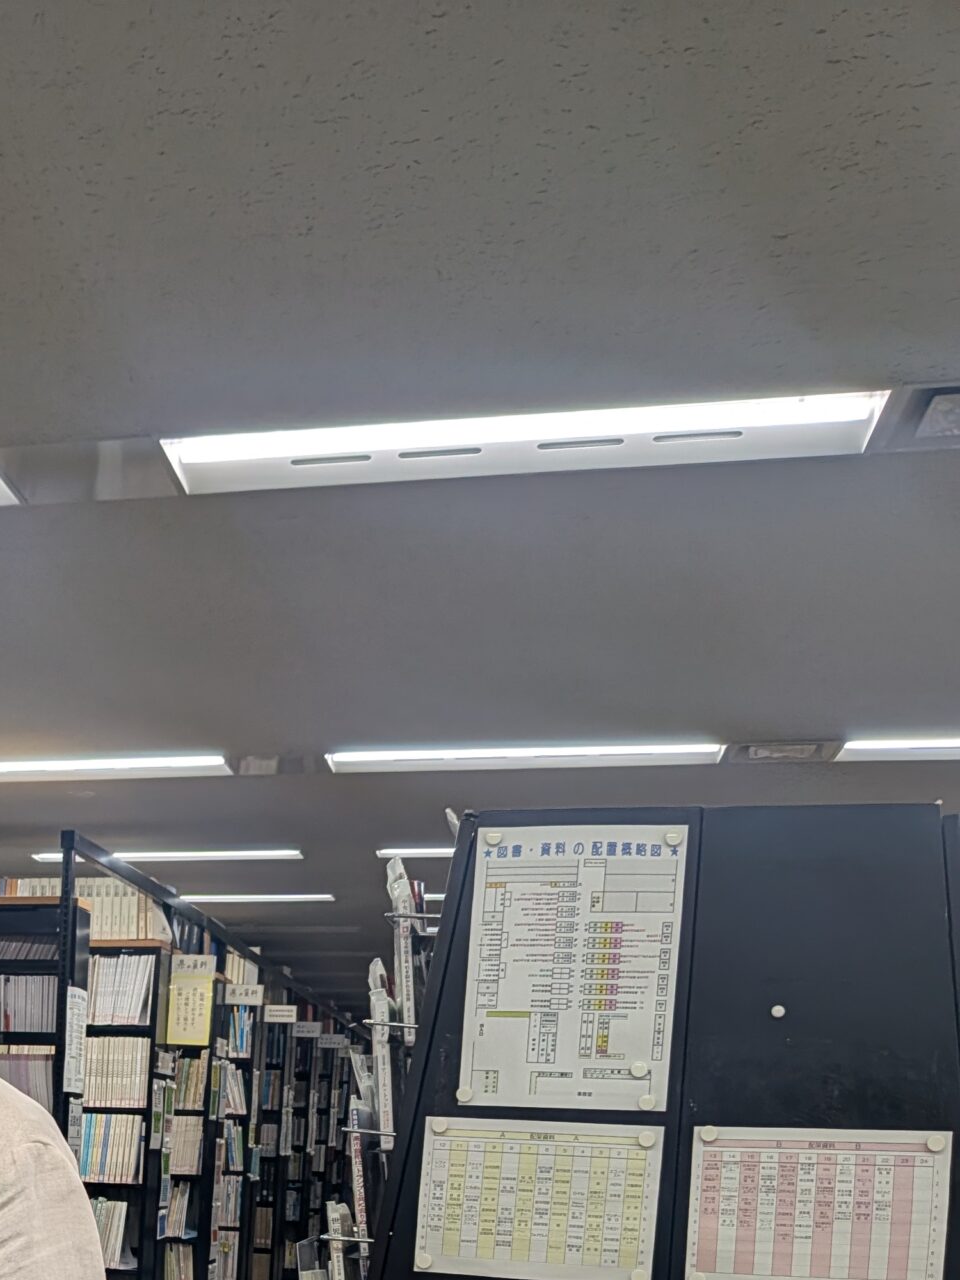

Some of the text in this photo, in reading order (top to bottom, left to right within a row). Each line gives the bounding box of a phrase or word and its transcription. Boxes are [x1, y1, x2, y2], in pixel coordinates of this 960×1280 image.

[497, 841, 662, 858] 図書・資料の配置概略図
[330, 1216, 341, 1235] 世界
